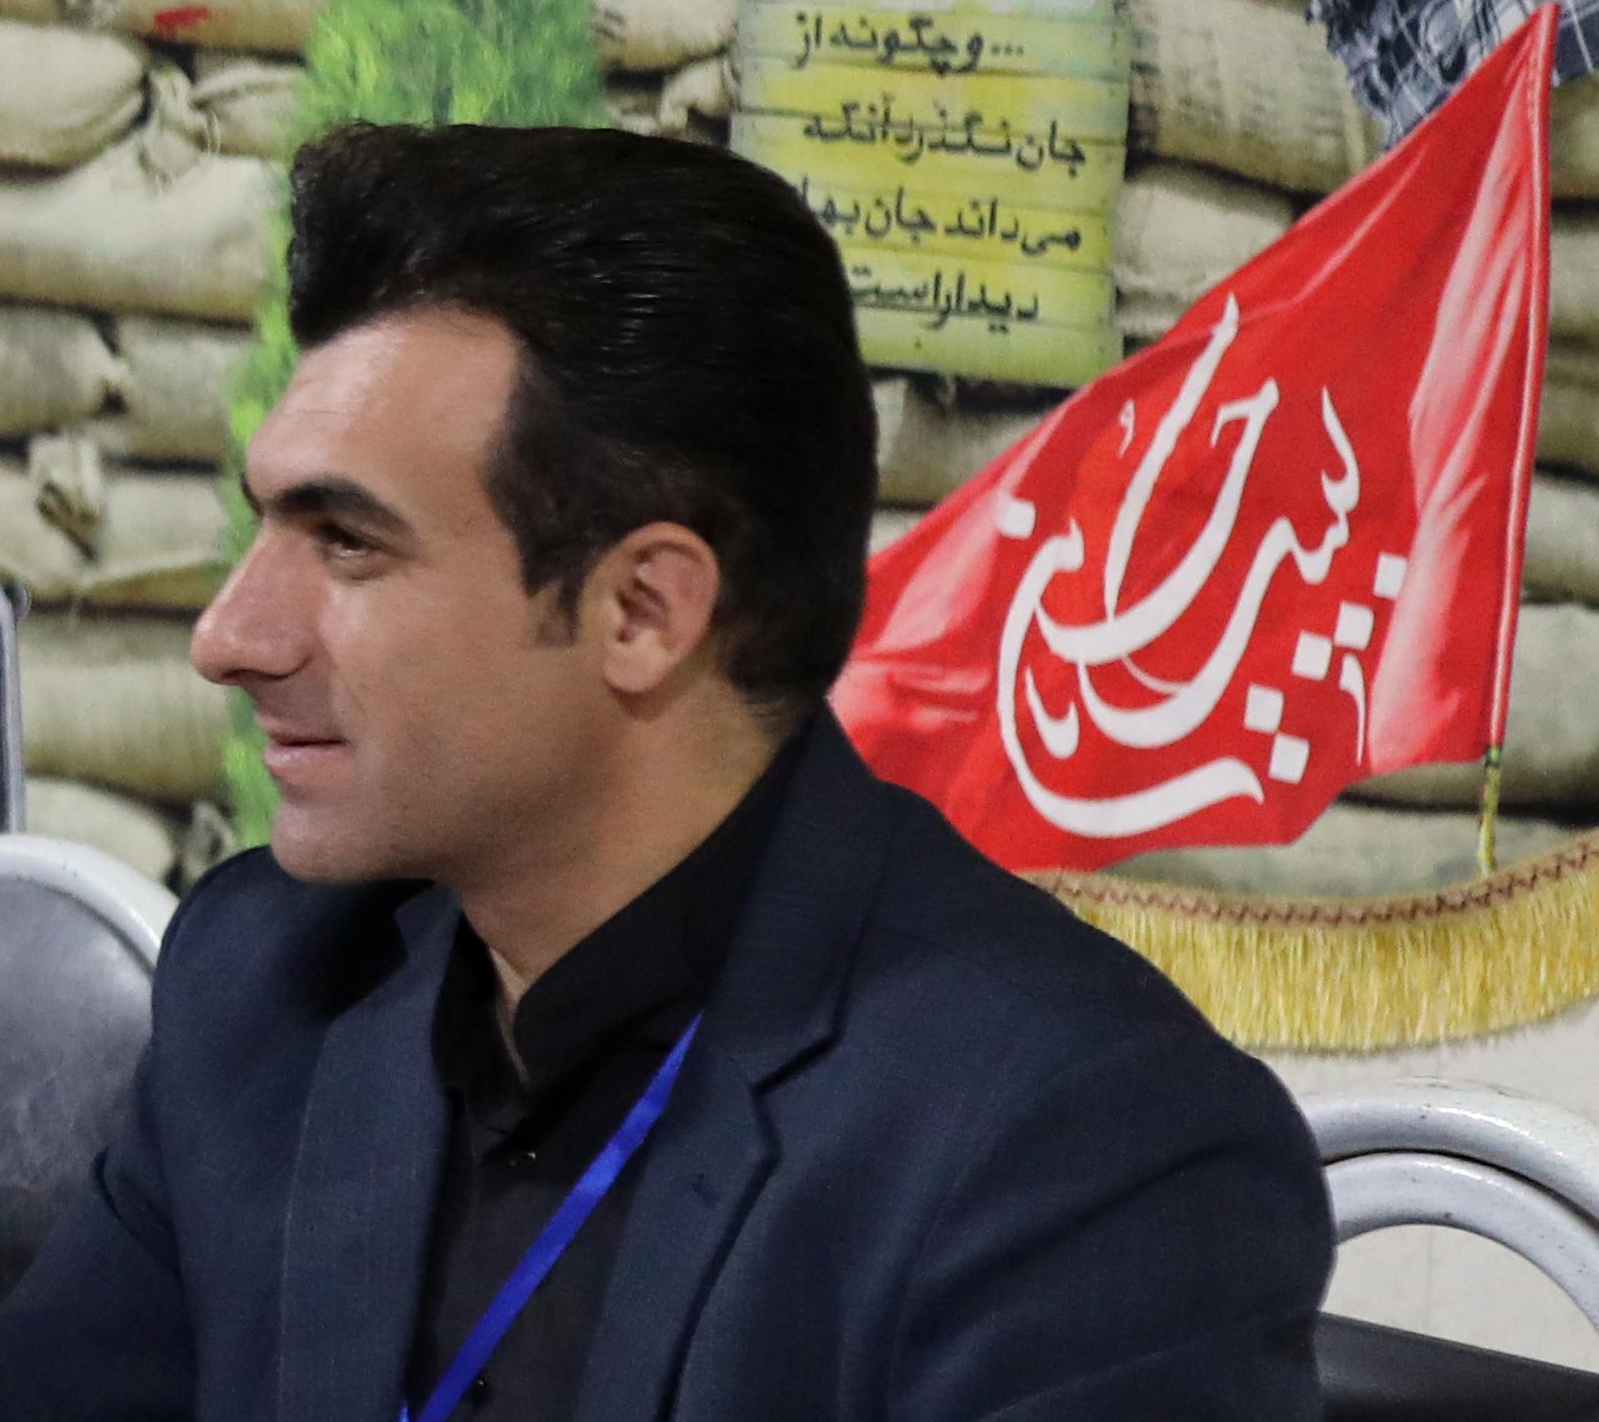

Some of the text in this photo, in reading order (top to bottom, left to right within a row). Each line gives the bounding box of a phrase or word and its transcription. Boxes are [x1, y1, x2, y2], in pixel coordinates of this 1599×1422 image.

[790, 11, 823, 70] از
[829, 13, 959, 77] چگونه
[895, 101, 1011, 164] نگذرد
[1016, 120, 1087, 179] جان
[864, 186, 937, 239] جان
[928, 270, 1039, 334] دیدار
